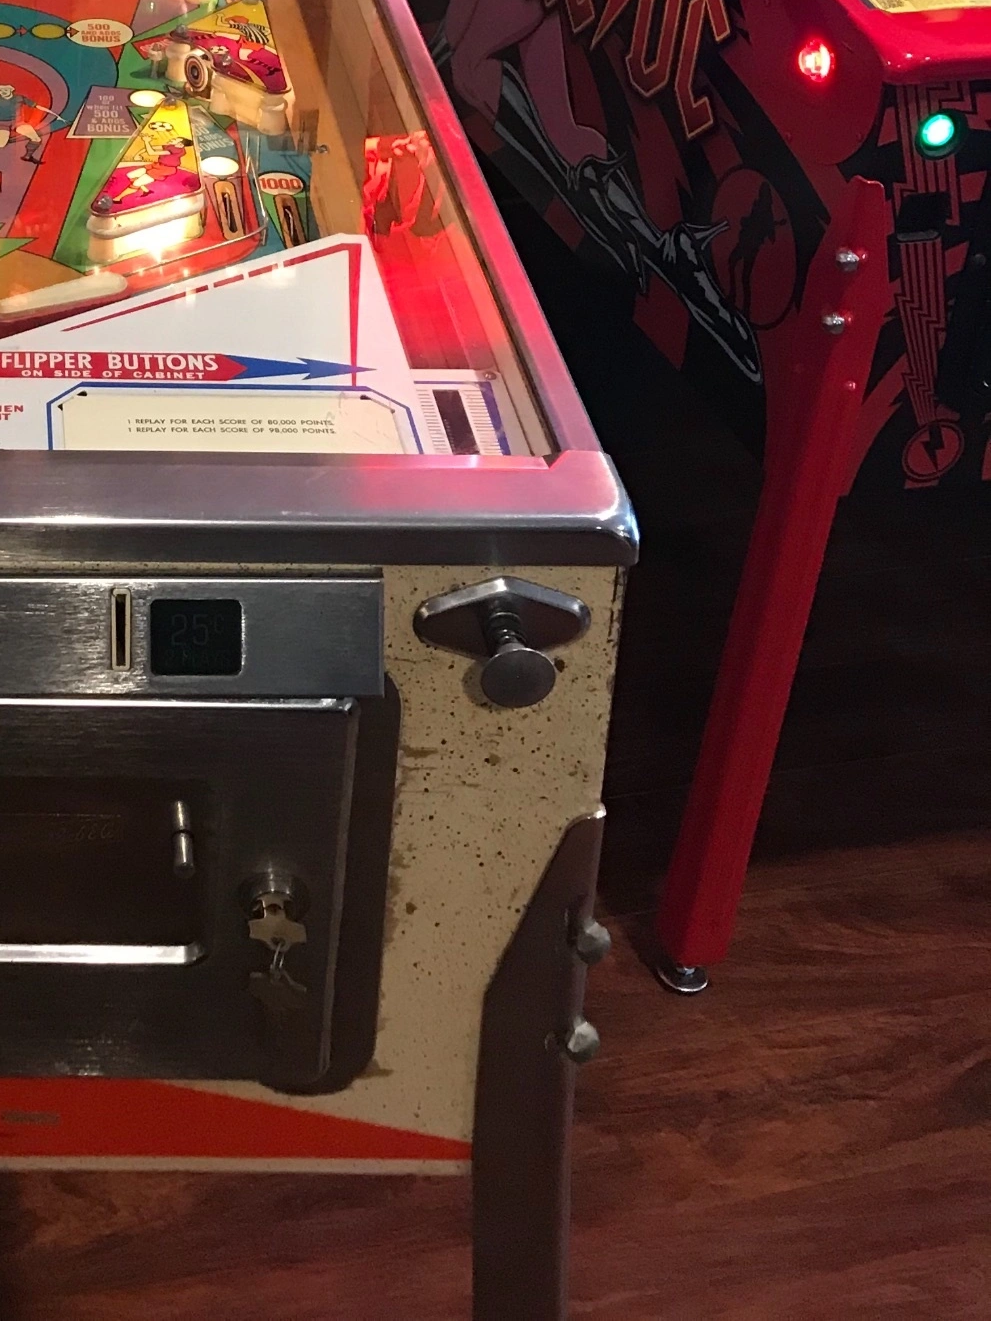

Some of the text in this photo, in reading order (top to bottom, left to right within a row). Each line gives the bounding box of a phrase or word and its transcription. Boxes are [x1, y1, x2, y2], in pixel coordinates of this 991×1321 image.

[82, 35, 121, 43] BONUS
[94, 110, 119, 118] 500
[87, 124, 130, 133] BONUS
[259, 177, 302, 191] 1000
[1, 352, 220, 373] FLIPPER BUTTONS
[54, 370, 92, 378] SIDE
[132, 371, 206, 380] CABINET
